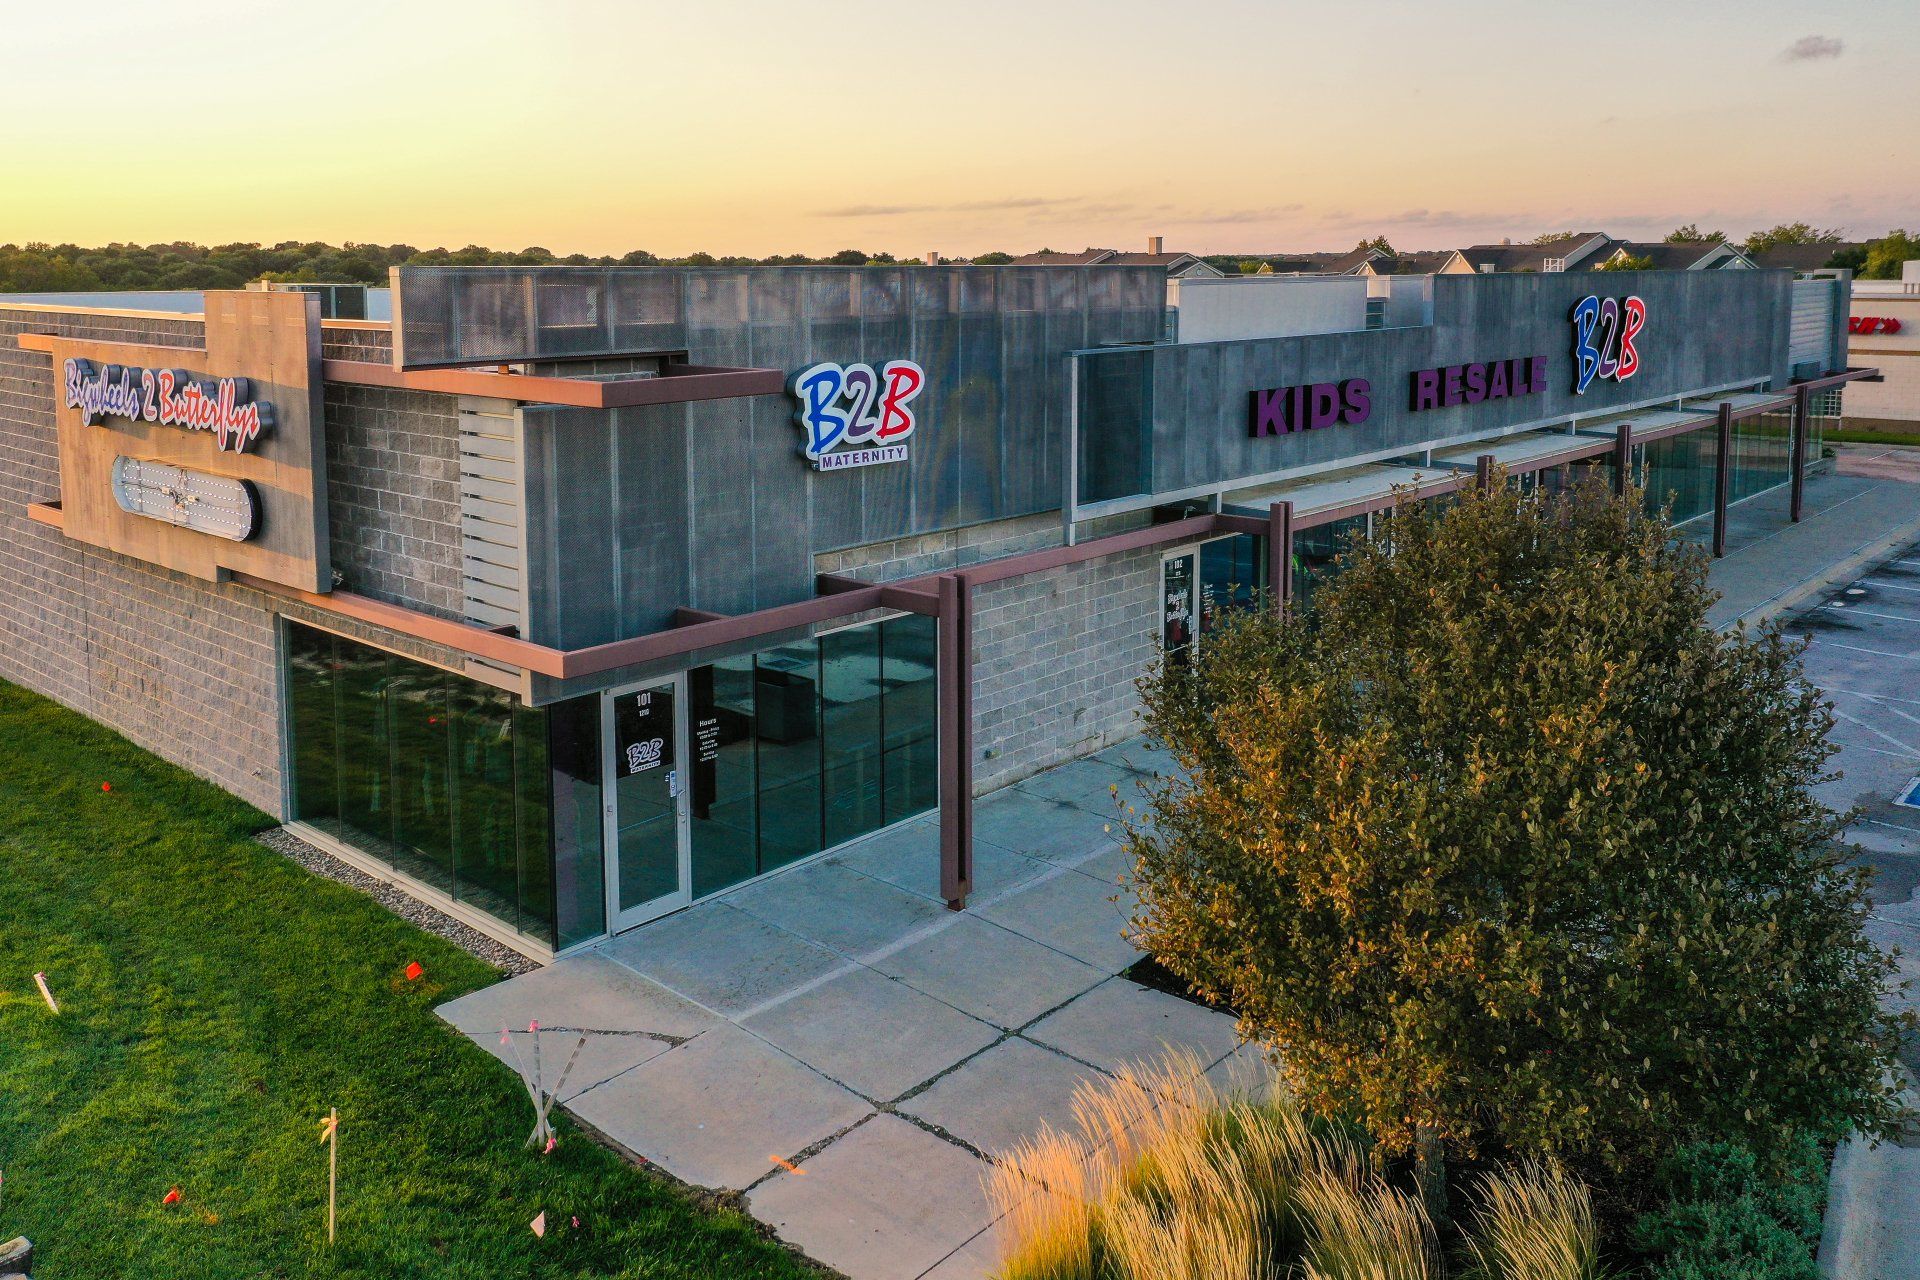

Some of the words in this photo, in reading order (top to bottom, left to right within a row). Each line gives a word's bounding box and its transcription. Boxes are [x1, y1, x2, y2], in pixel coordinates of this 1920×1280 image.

[1571, 294, 1647, 396] B2B
[63, 358, 140, 427] Bigwheels
[142, 368, 158, 421] 2
[159, 368, 261, 454] Butterflys
[795, 360, 925, 461] B2B
[1252, 378, 1371, 438] KIDS
[1413, 355, 1548, 412] RESALE
[821, 447, 905, 469] MATERNITY
[636, 692, 651, 707] 101
[699, 718, 717, 727] Hours
[626, 737, 664, 768] B2B
